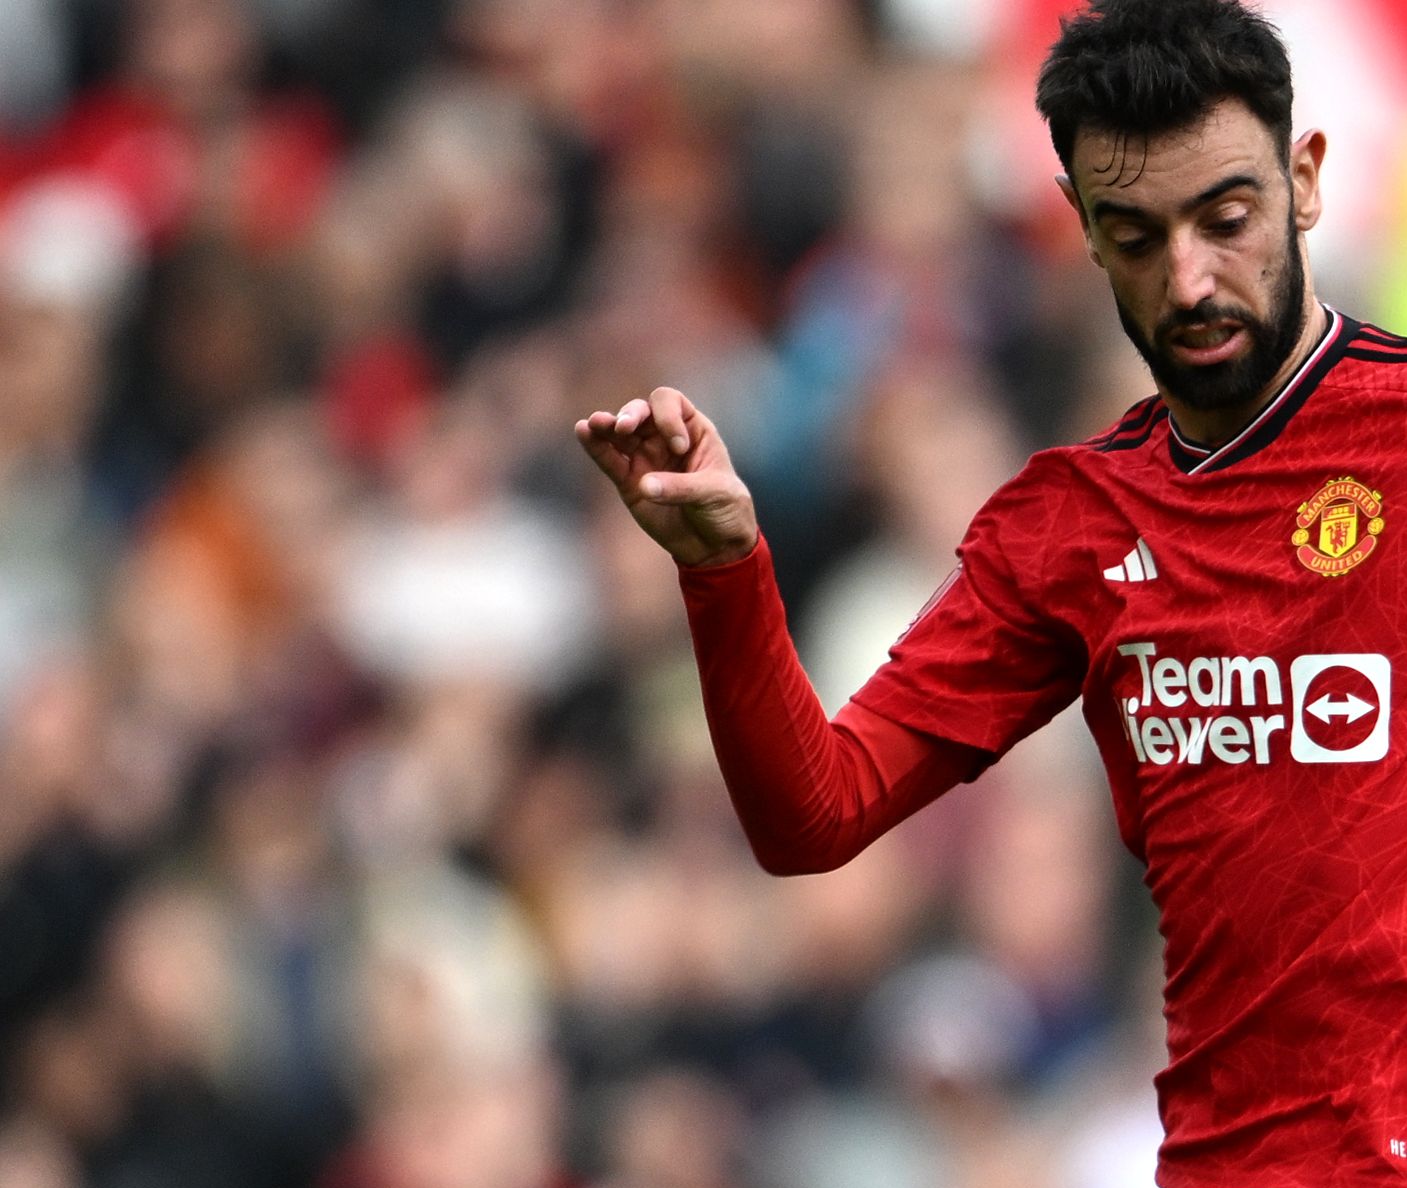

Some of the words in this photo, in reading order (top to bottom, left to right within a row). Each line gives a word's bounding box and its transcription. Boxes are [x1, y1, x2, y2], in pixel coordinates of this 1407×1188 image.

[1302, 484, 1376, 522] MANCHESTER
[1310, 550, 1363, 571] UNITED
[1116, 642, 1284, 708] Team
[1114, 696, 1286, 766] iewer
